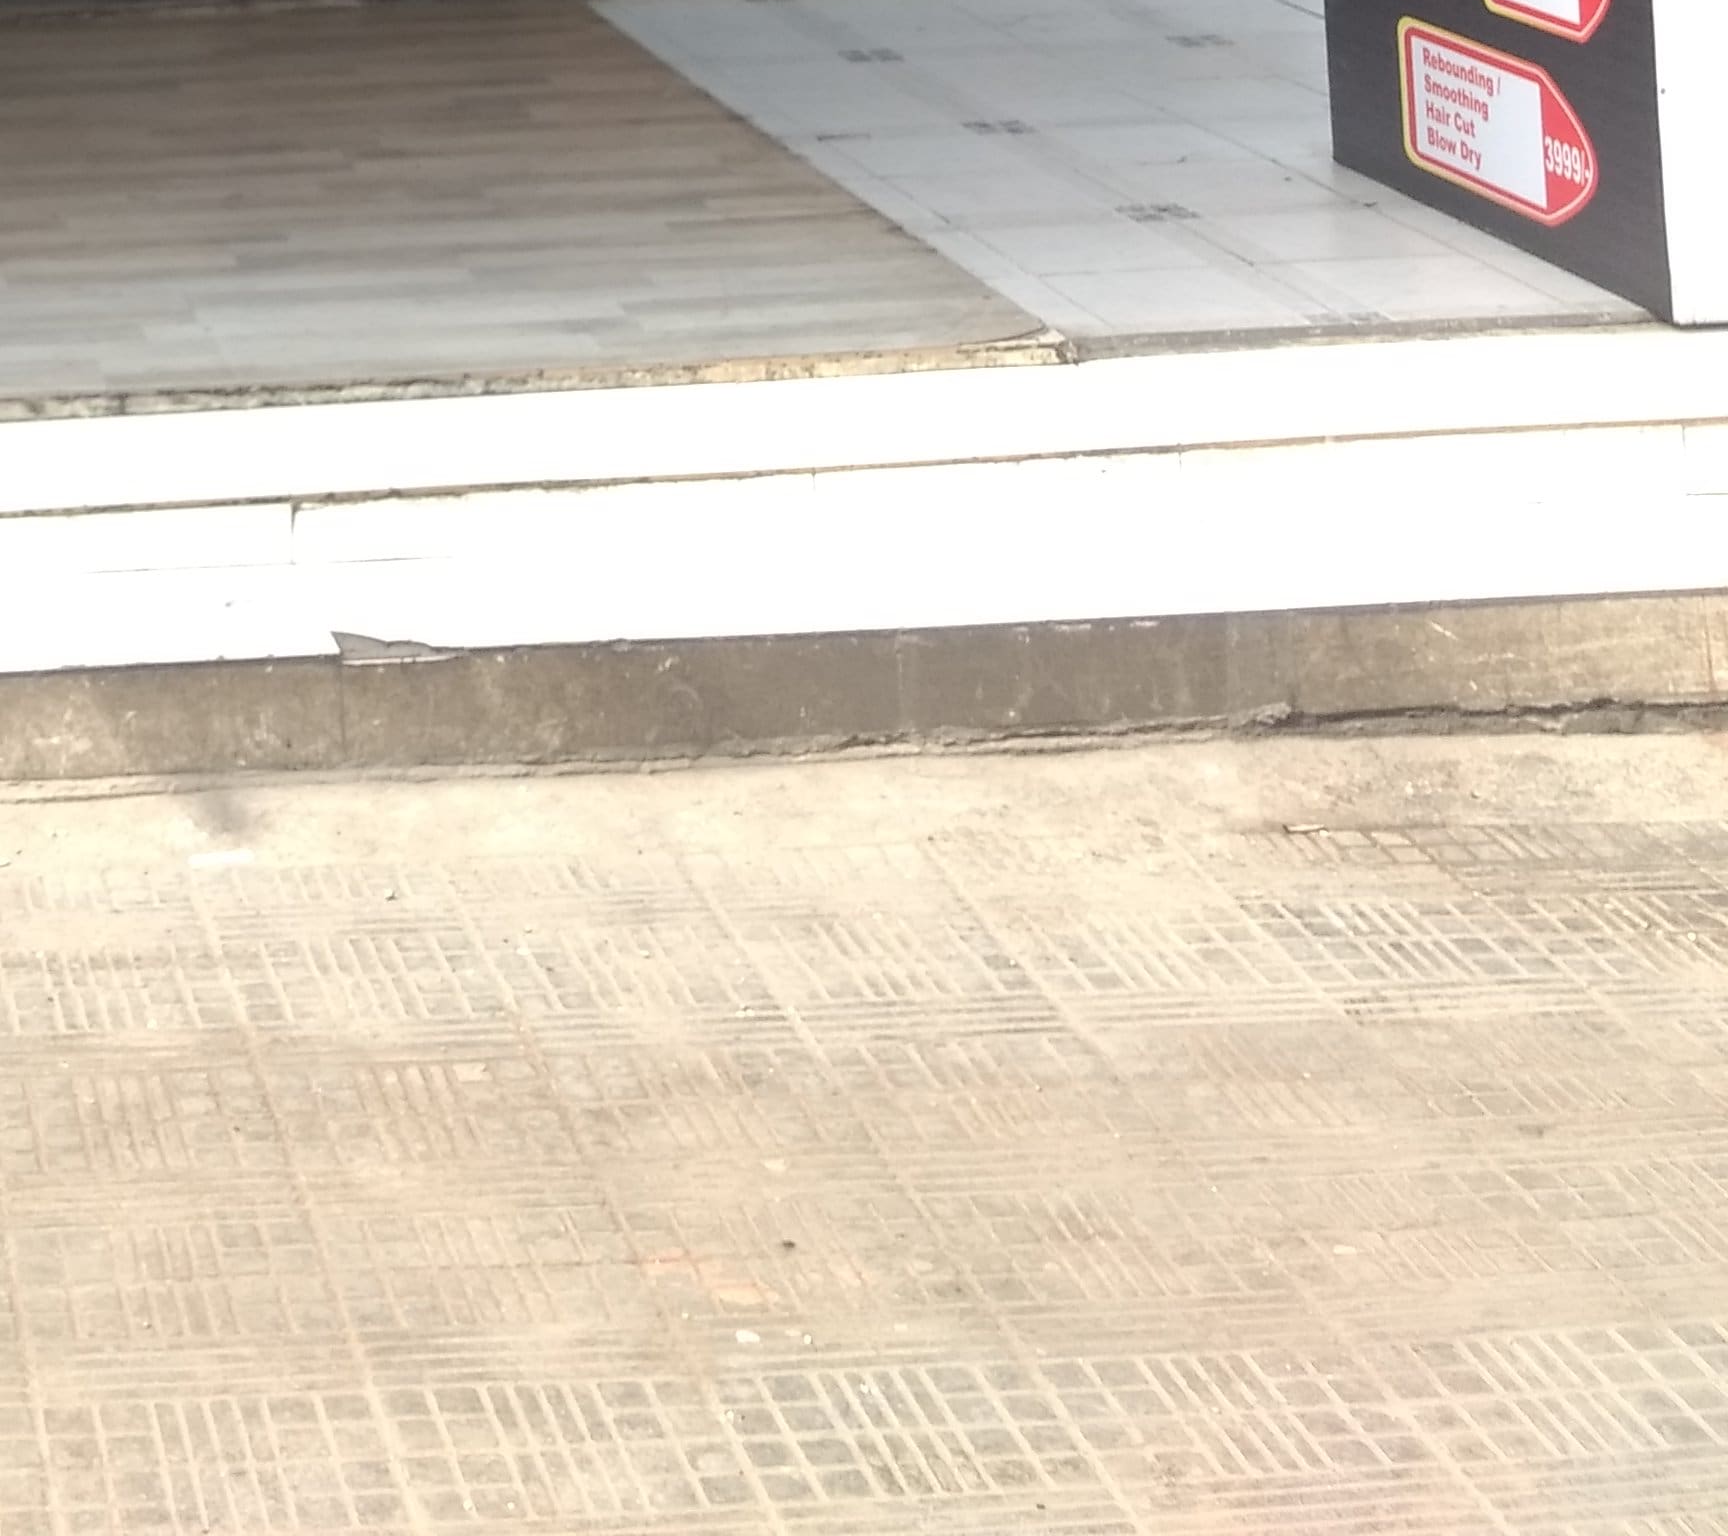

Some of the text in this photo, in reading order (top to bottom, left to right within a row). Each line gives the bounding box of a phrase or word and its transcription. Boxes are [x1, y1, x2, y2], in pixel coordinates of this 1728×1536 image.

[1422, 47, 1495, 96] Rebounding
[1424, 74, 1490, 122] Smoothing
[1425, 99, 1477, 138] Hair Cut
[1426, 125, 1483, 171] Blow Dry
